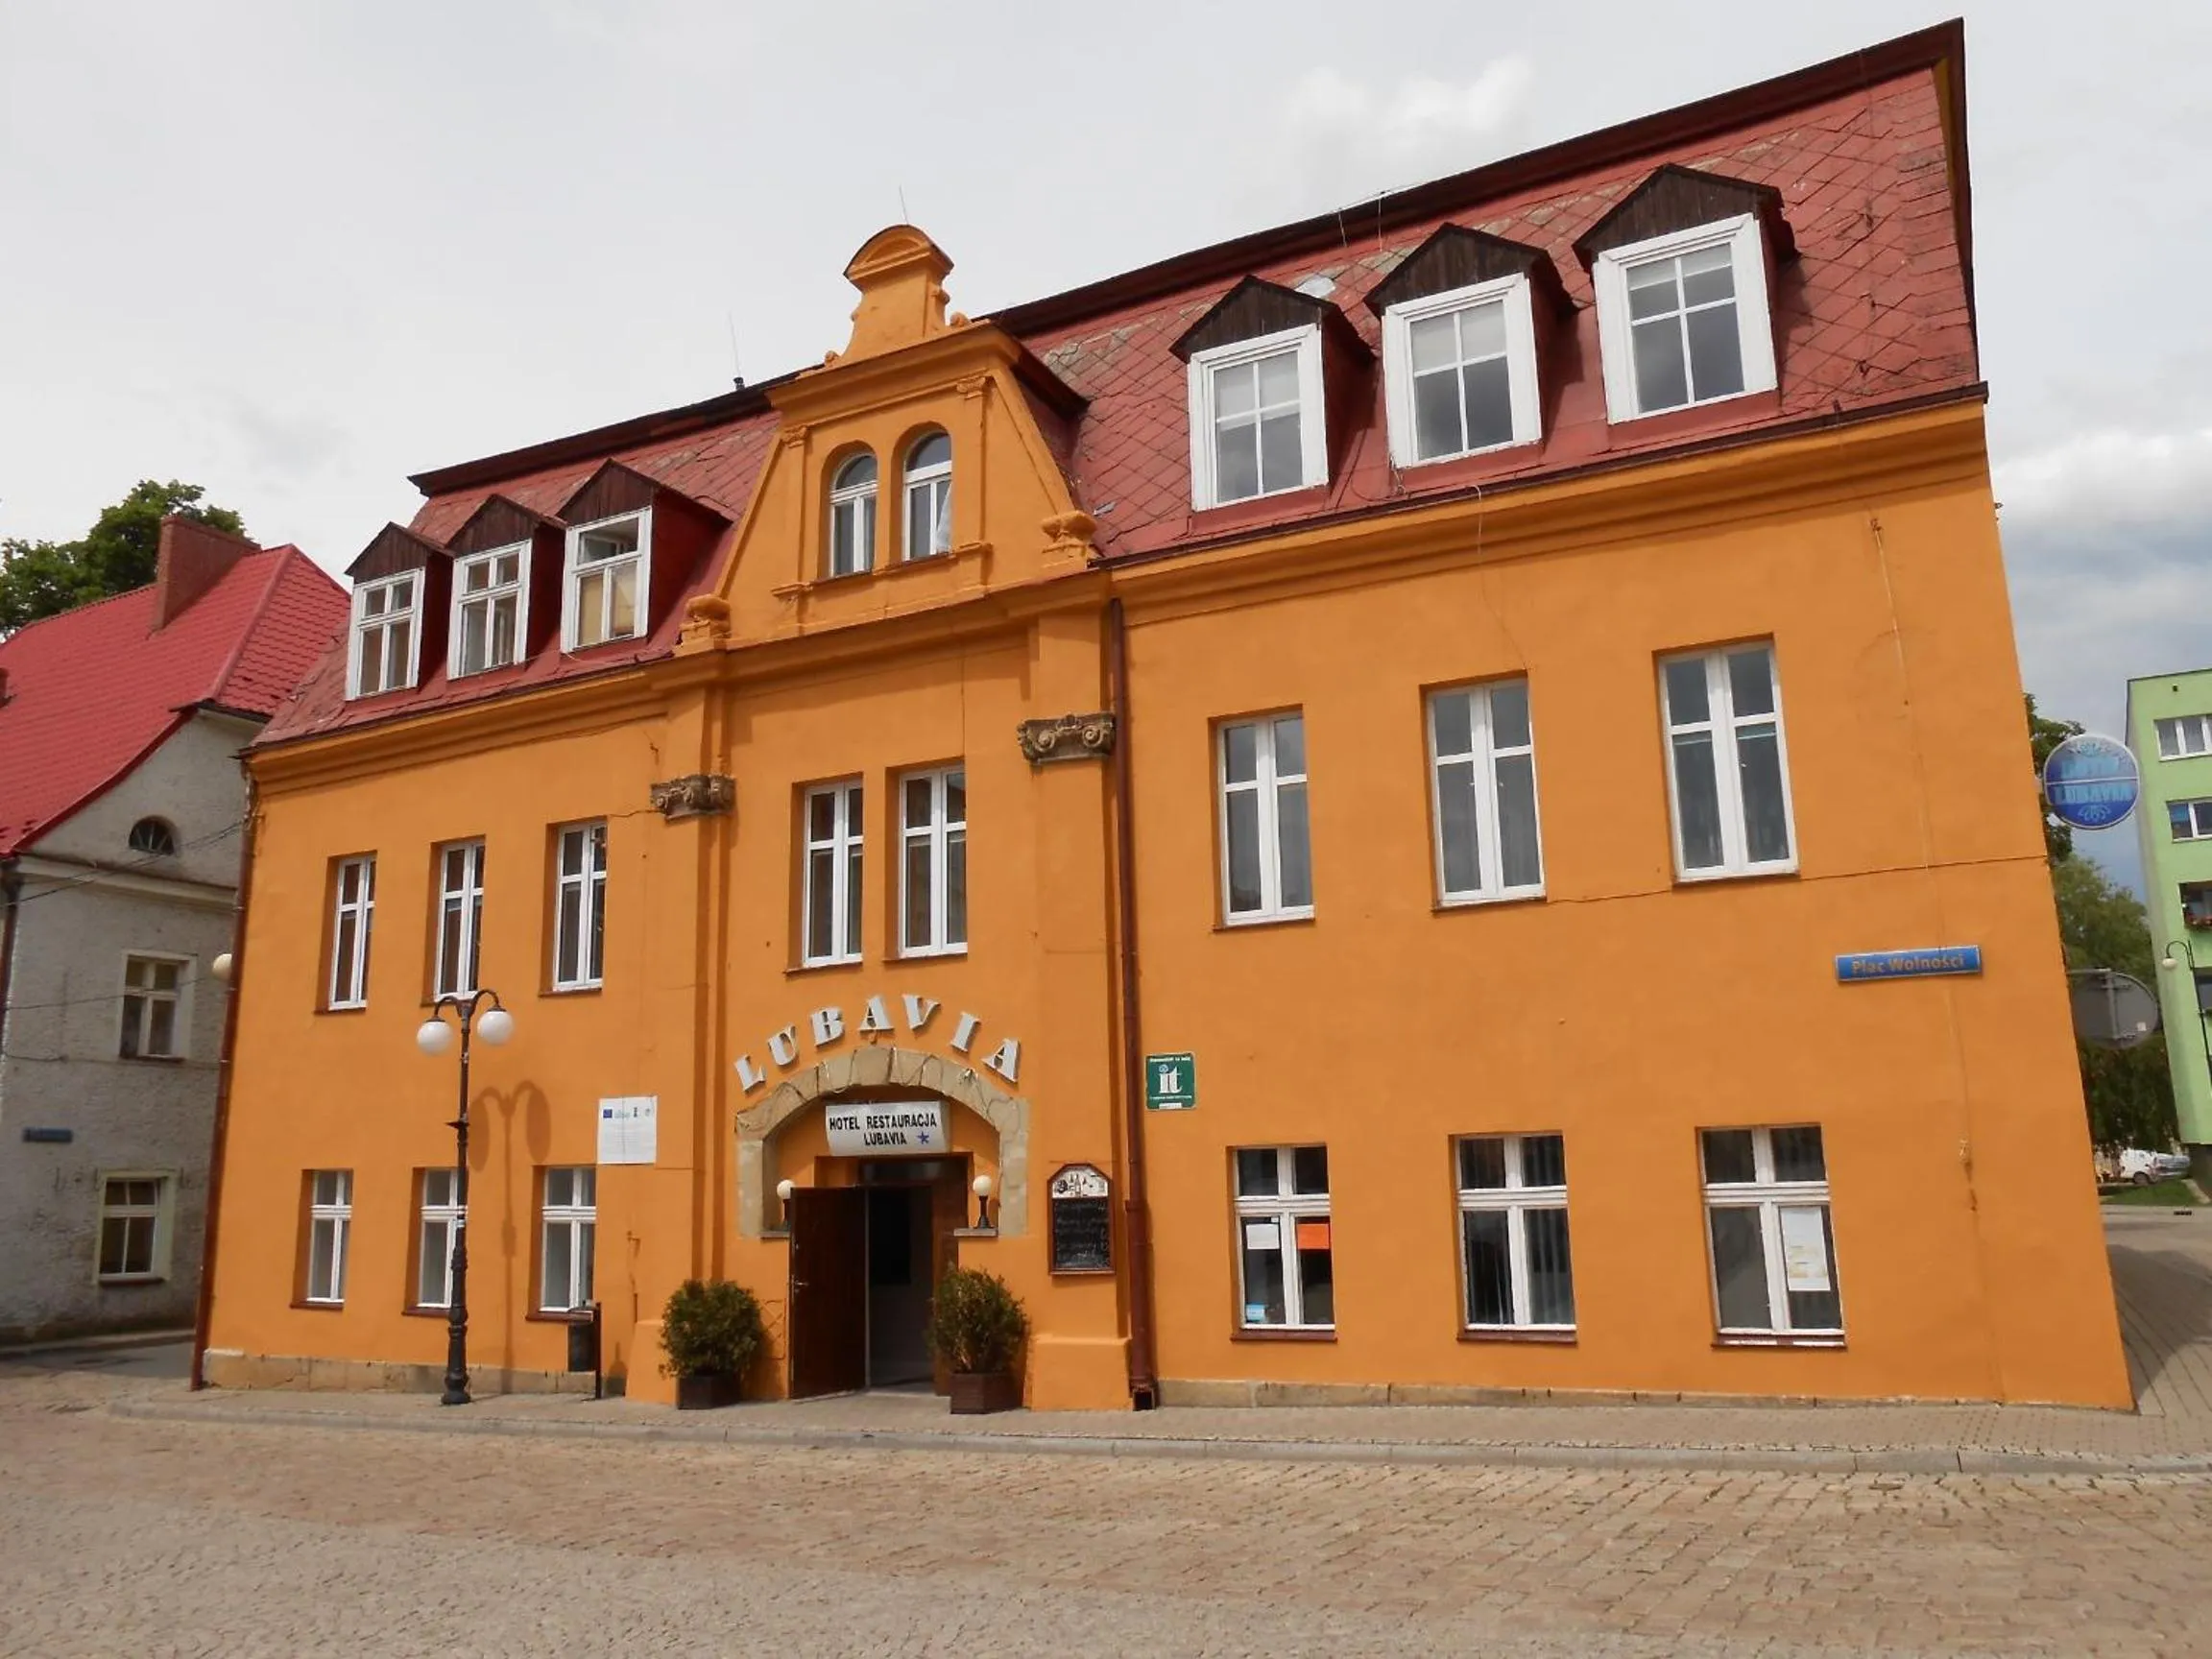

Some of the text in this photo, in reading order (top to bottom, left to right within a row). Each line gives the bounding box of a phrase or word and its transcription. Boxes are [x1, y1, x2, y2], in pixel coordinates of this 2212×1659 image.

[1851, 953, 1964, 974] Plac Wolności
[733, 994, 1022, 1093] LUBAVIA
[830, 1113, 937, 1130] HOTEL RESTAURACJA
[864, 1132, 907, 1145] LUBAVIA
